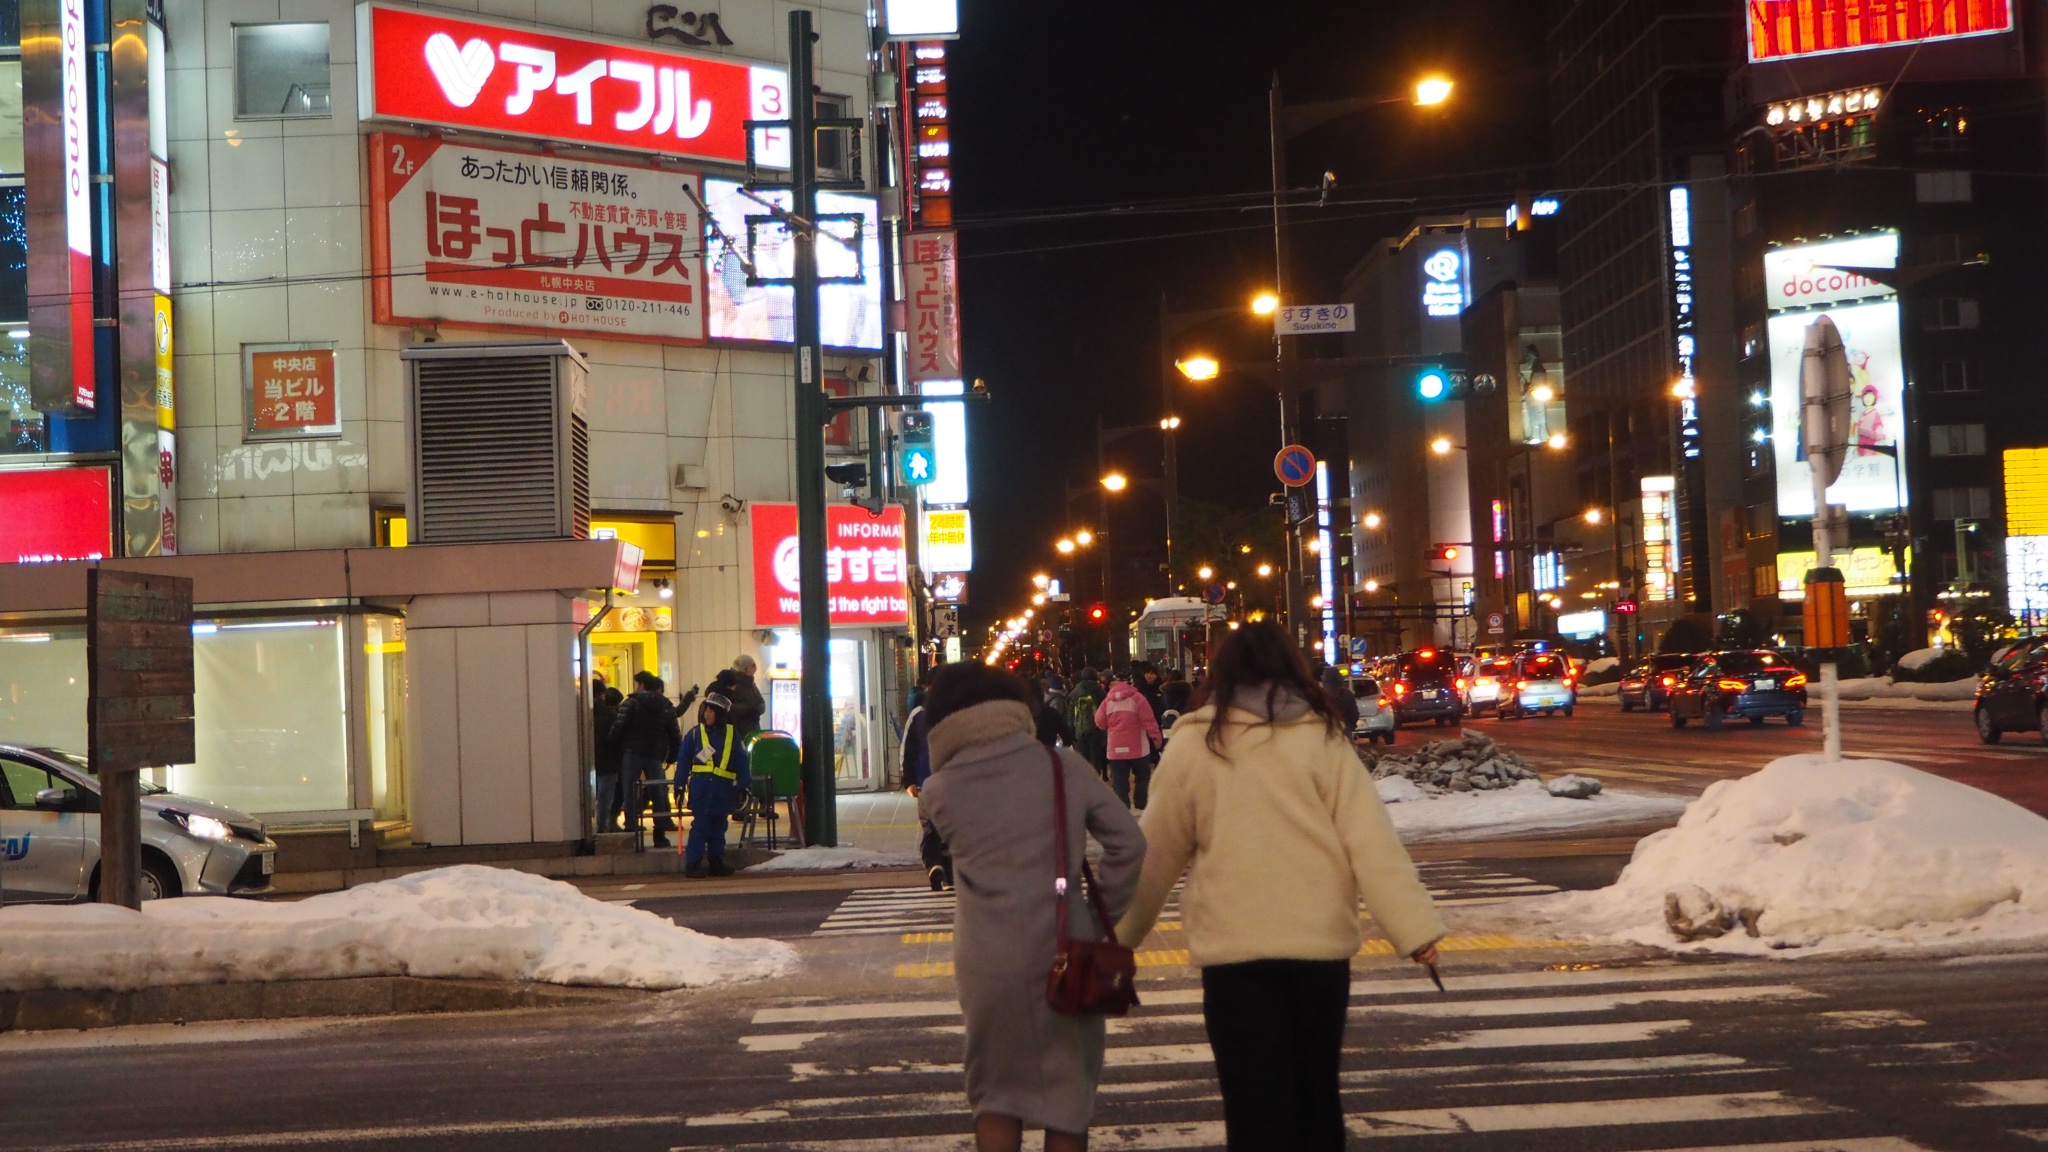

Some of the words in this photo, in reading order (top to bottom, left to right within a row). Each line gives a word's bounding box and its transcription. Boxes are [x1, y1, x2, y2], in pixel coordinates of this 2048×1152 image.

[499, 41, 712, 139] アイフル
[391, 144, 414, 176] 2F
[461, 156, 637, 199] あったかい信頼関係。
[426, 190, 690, 280] ほっとハウス
[540, 275, 596, 292] 札幌中央店
[429, 285, 578, 307] www.e-hothouse.jp
[605, 298, 690, 316] 0120-211-446
[913, 239, 940, 373] ほっとハウス
[484, 305, 540, 320] Produced
[543, 311, 557, 323] by
[571, 313, 591, 325] HOT
[593, 315, 627, 327] HOUSE
[1282, 305, 1348, 323] すすきの
[1293, 322, 1337, 332] Susukino
[273, 357, 316, 372] 中央店
[264, 378, 325, 399] 当ビル
[274, 401, 317, 421] 2階
[929, 515, 966, 530] 24時間
[929, 531, 966, 545] 年中無休
[839, 597, 859, 613] the
[861, 597, 888, 615] right
